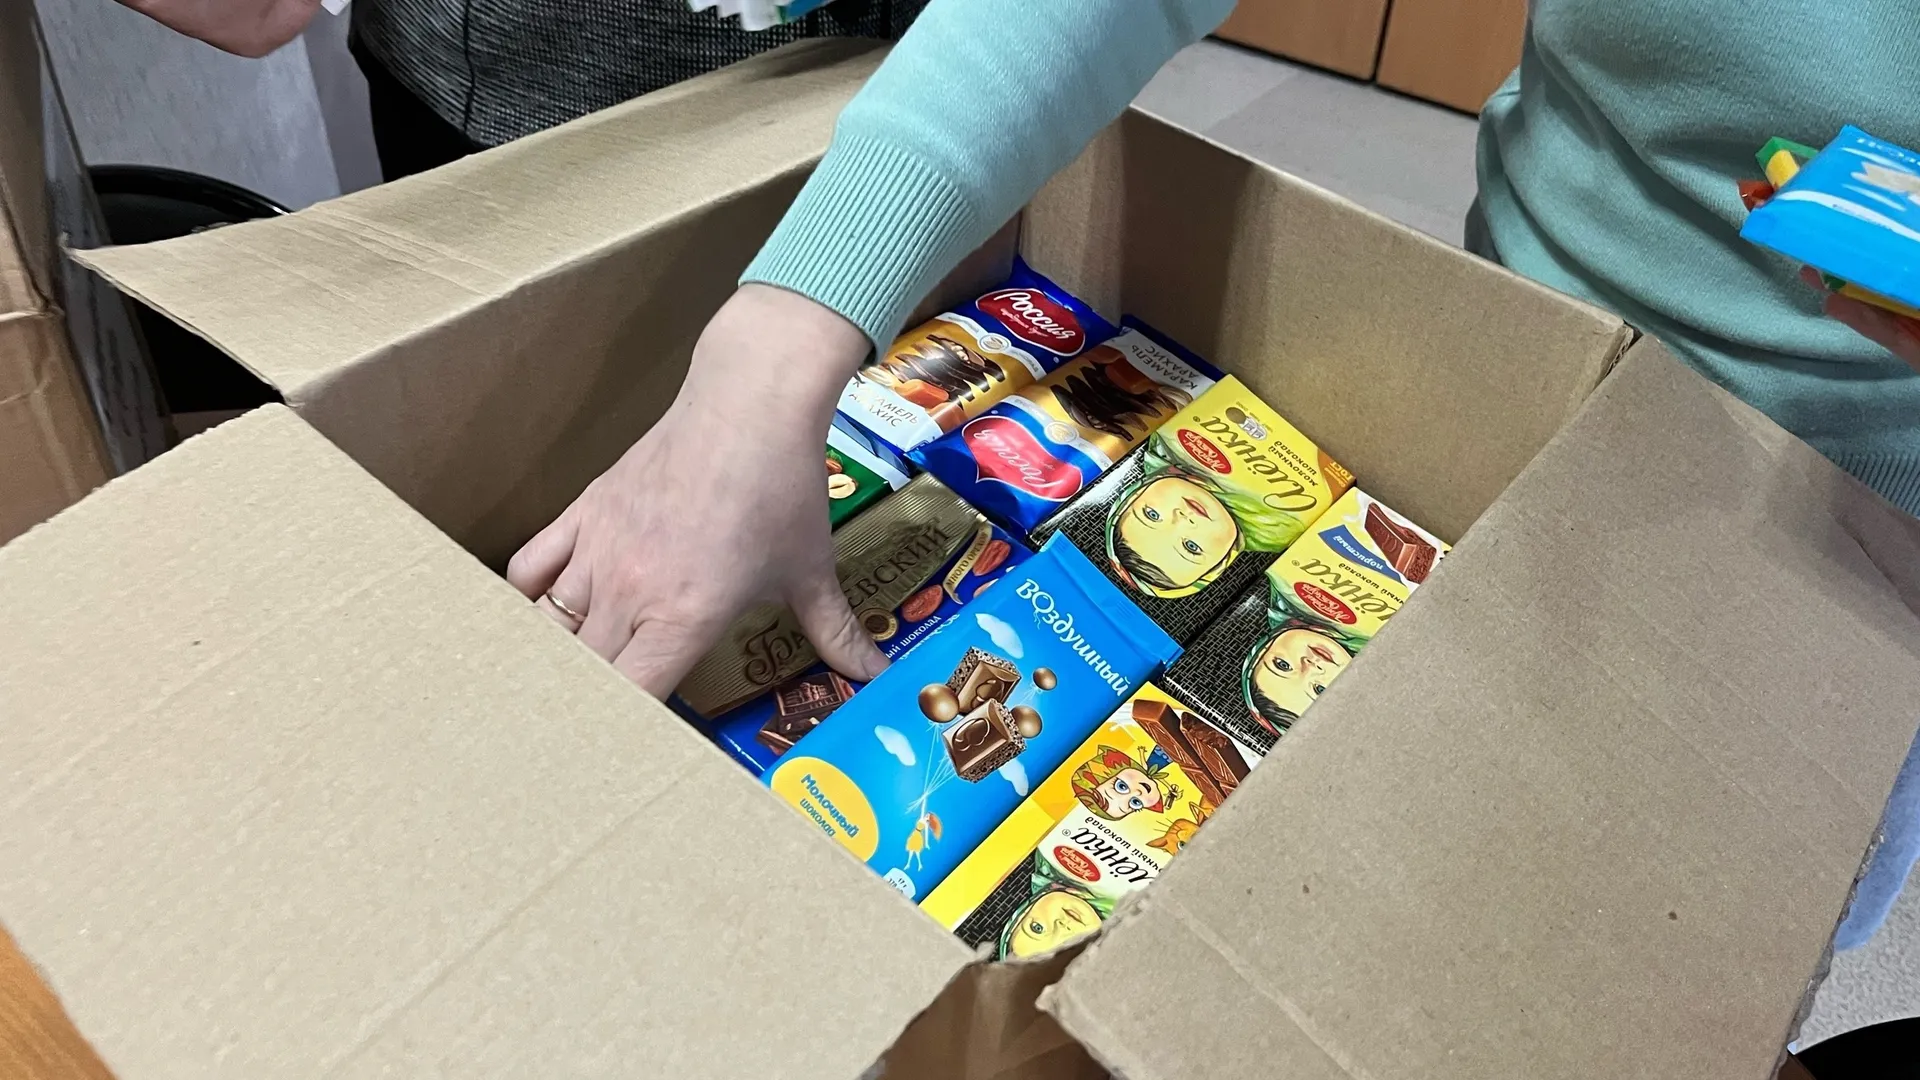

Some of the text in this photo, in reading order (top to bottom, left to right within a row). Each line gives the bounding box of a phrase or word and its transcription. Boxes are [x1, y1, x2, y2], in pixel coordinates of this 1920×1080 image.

[994, 292, 1075, 339] Россия
[1132, 344, 1198, 390] КАРАМЕЛЬ
[1145, 345, 1199, 378] АРАХИС
[1200, 416, 1317, 511] Алёнка
[1268, 445, 1318, 487] молочный
[1274, 440, 1317, 476] шоколад
[1333, 534, 1384, 571] пористый
[1299, 558, 1398, 622] лёнка
[1338, 562, 1380, 590] шоколад
[799, 798, 837, 837] шоколад
[801, 773, 860, 838] Молочный
[1085, 816, 1132, 849] шоколад
[1070, 827, 1154, 883] лёнка
